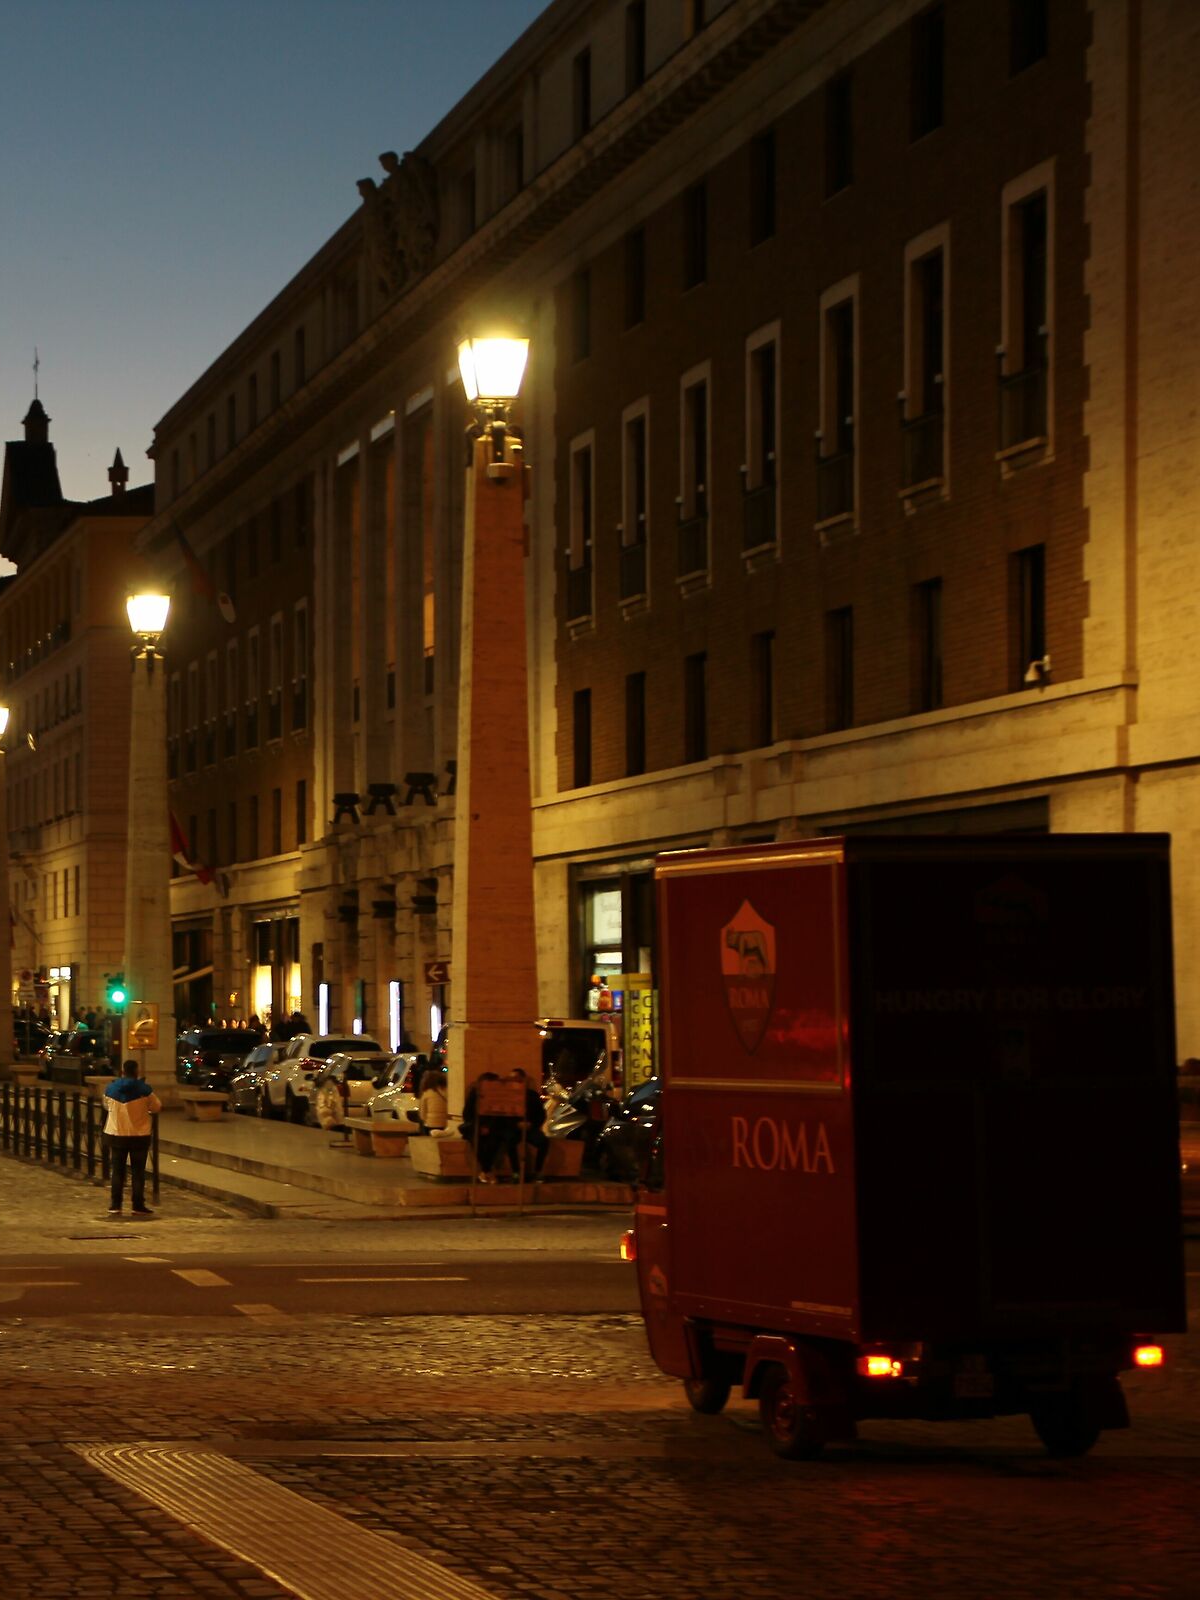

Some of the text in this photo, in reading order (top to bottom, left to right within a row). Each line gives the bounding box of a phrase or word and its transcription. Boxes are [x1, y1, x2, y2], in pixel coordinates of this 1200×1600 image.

[728, 987, 770, 1009] ROMA
[874, 988, 987, 1013] HUNGRY
[995, 987, 1049, 1012] FOR
[632, 1004, 641, 1082] CHANGE
[731, 1116, 836, 1174] ROMA
